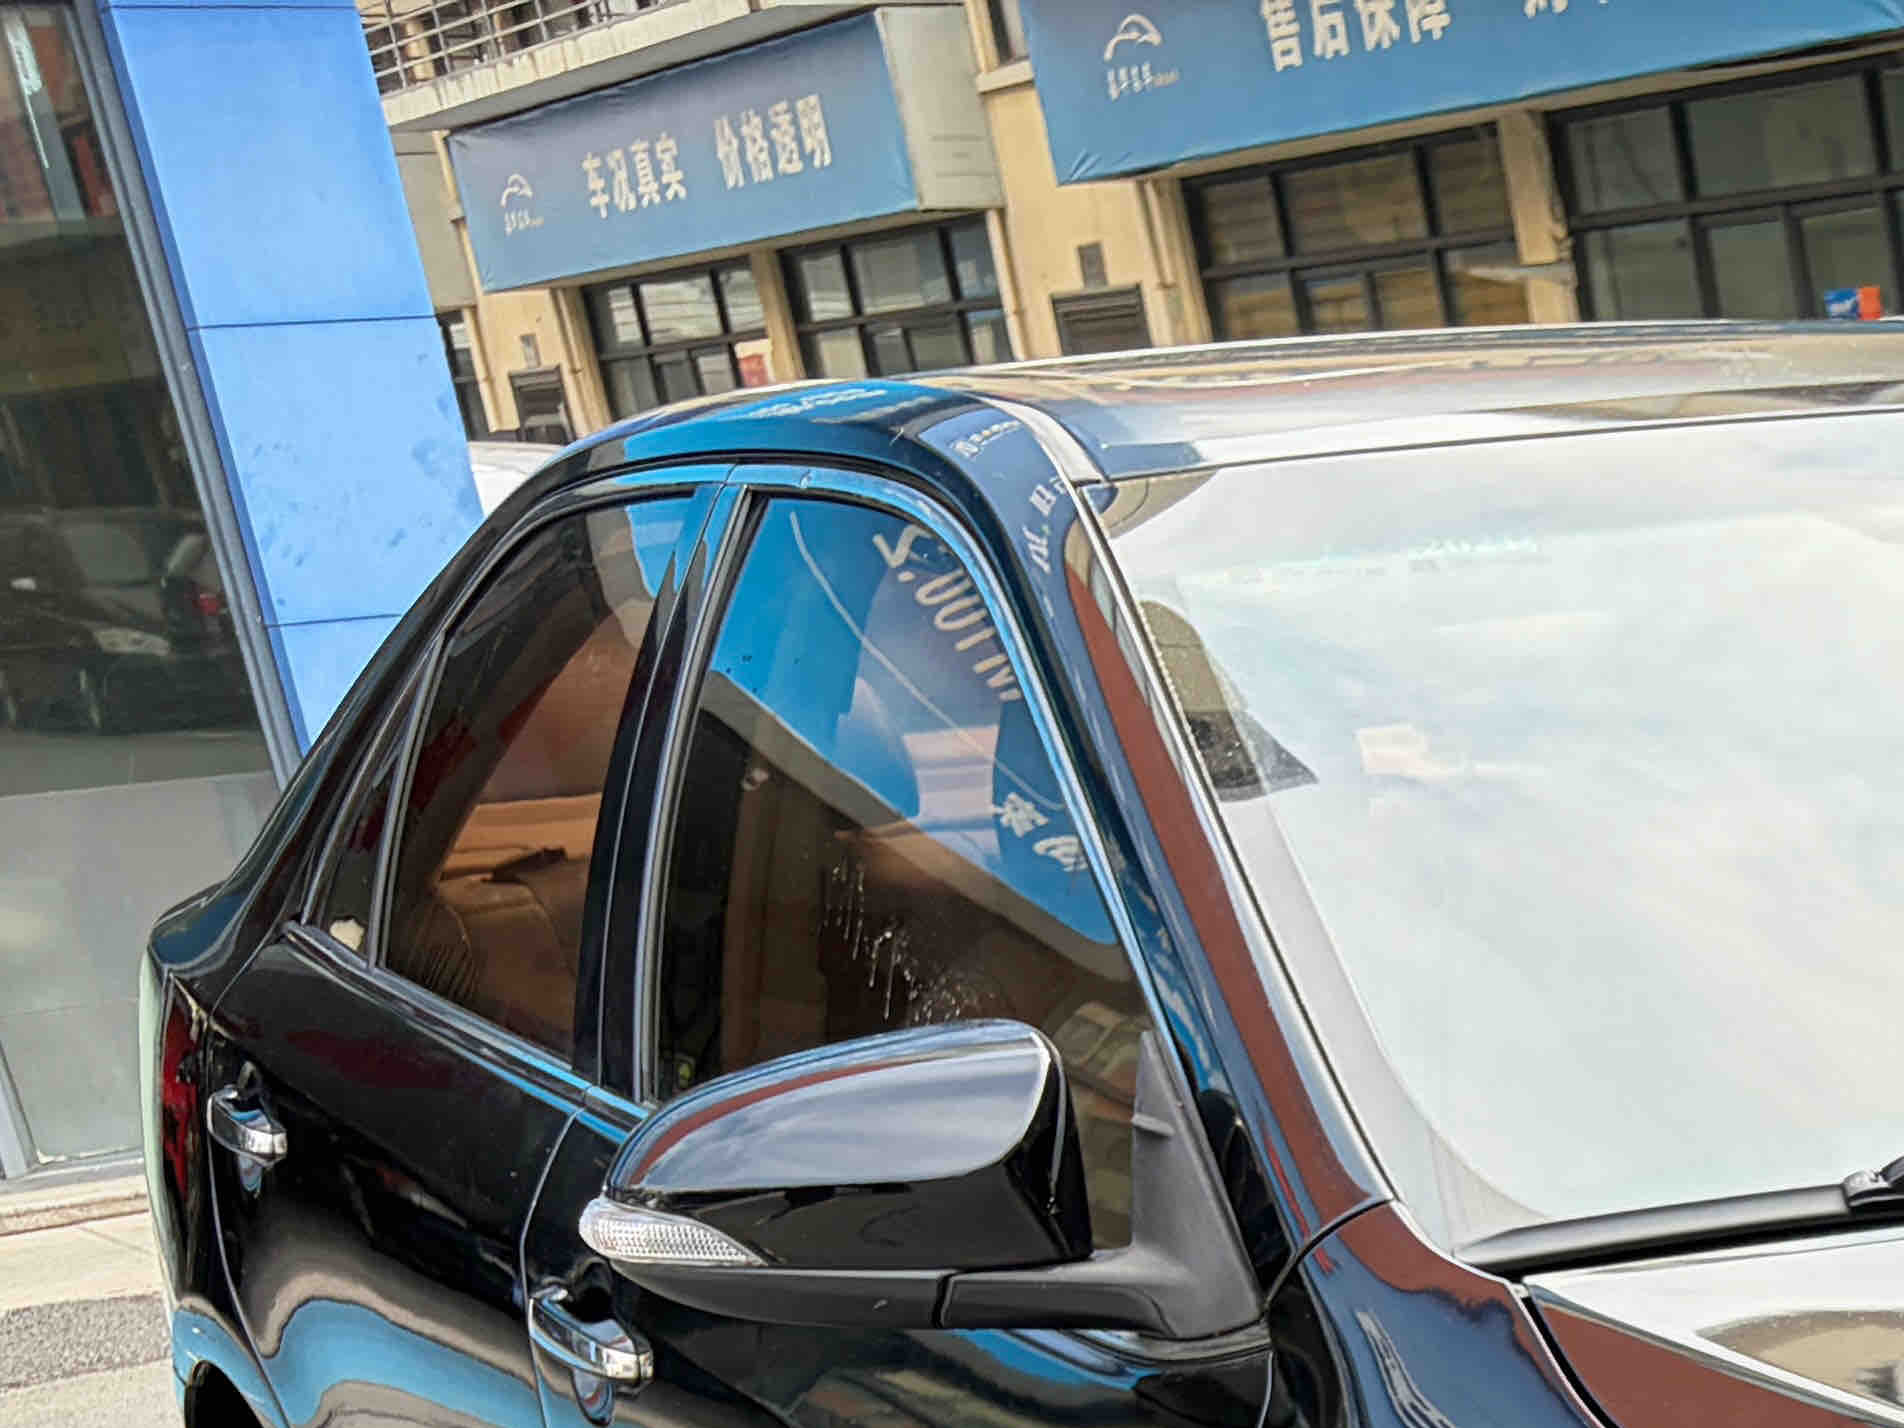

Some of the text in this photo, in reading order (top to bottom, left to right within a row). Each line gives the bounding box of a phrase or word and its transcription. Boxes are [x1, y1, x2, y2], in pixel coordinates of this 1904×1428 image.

[582, 94, 832, 218] 车况真实 价格透明
